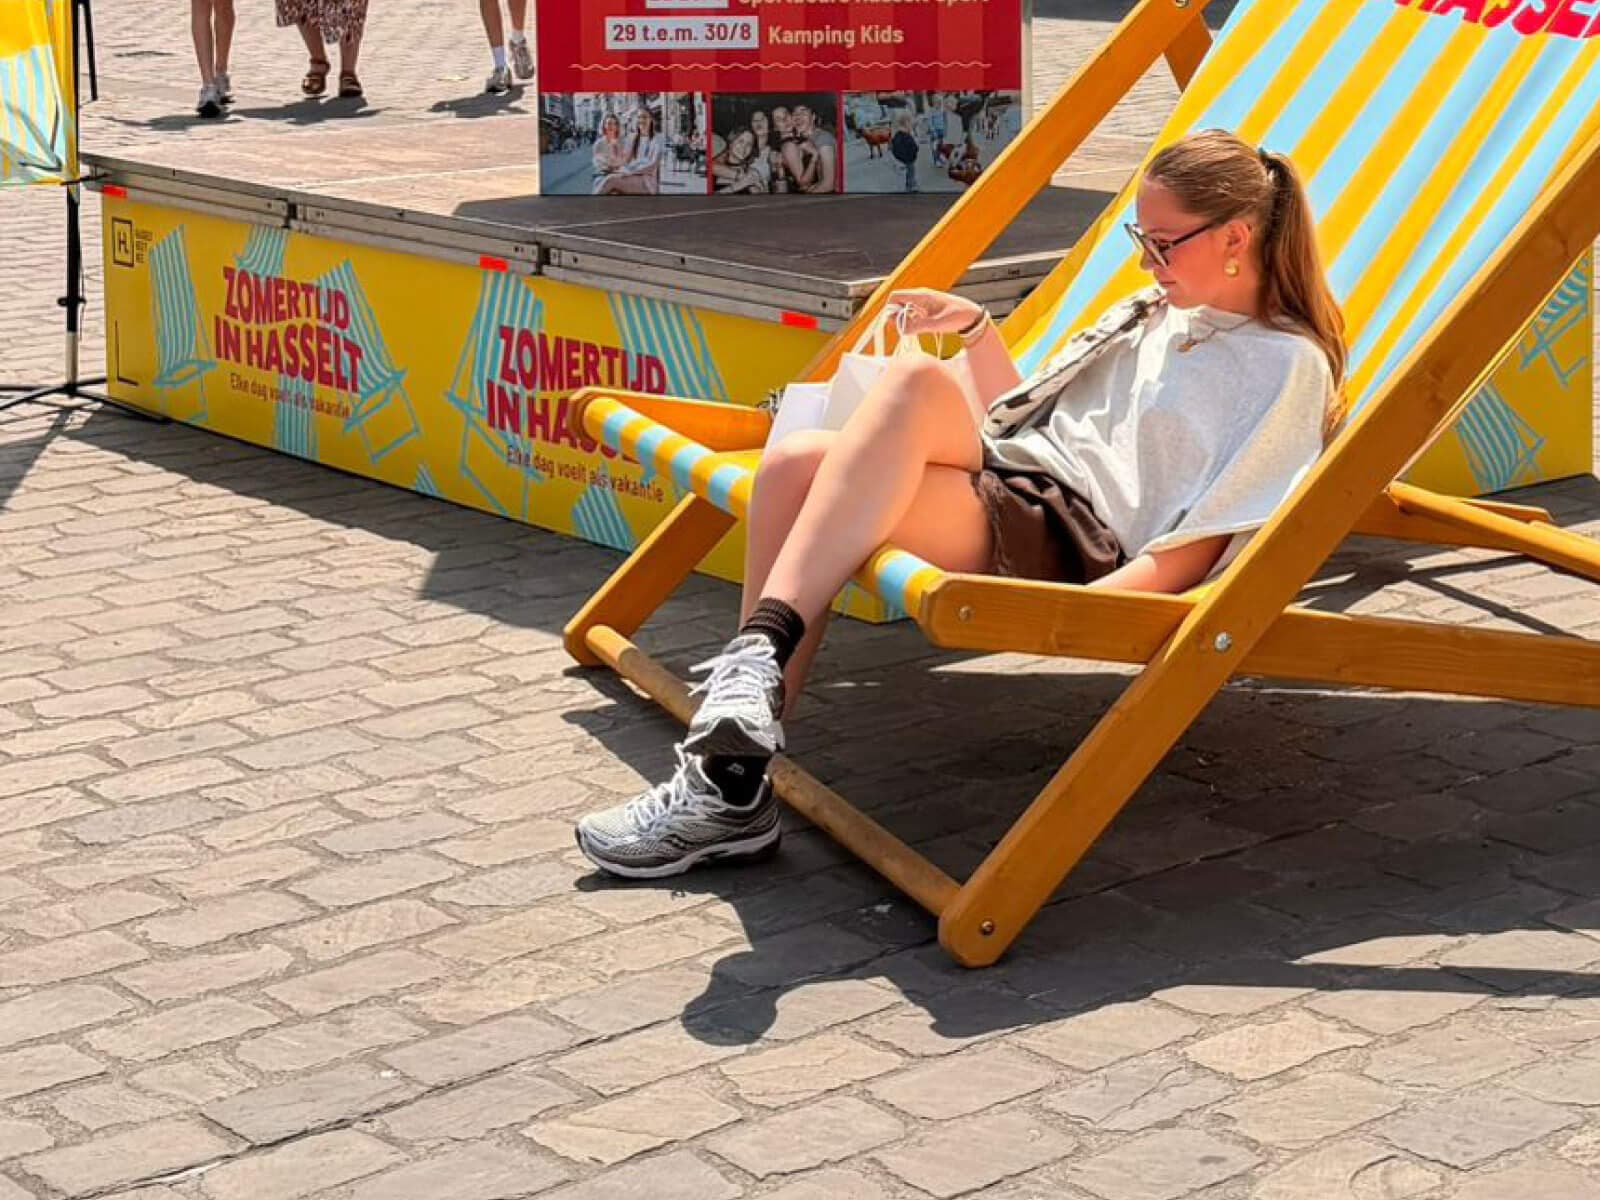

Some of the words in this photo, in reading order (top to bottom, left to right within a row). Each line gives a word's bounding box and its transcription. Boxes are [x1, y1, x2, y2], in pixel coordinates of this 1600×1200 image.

[612, 23, 636, 42] 29
[642, 24, 698, 42] t.e.m.
[704, 22, 752, 42] 30/8
[768, 25, 855, 48] Kamping
[861, 24, 904, 44] Kids
[222, 266, 351, 329] ZOMERTIJD
[215, 315, 241, 362] IN
[246, 323, 364, 392] HASSELT
[499, 325, 668, 395] ZOMERTIJD
[487, 379, 521, 434] IN
[534, 454, 555, 478] dag
[557, 462, 587, 482] voelt
